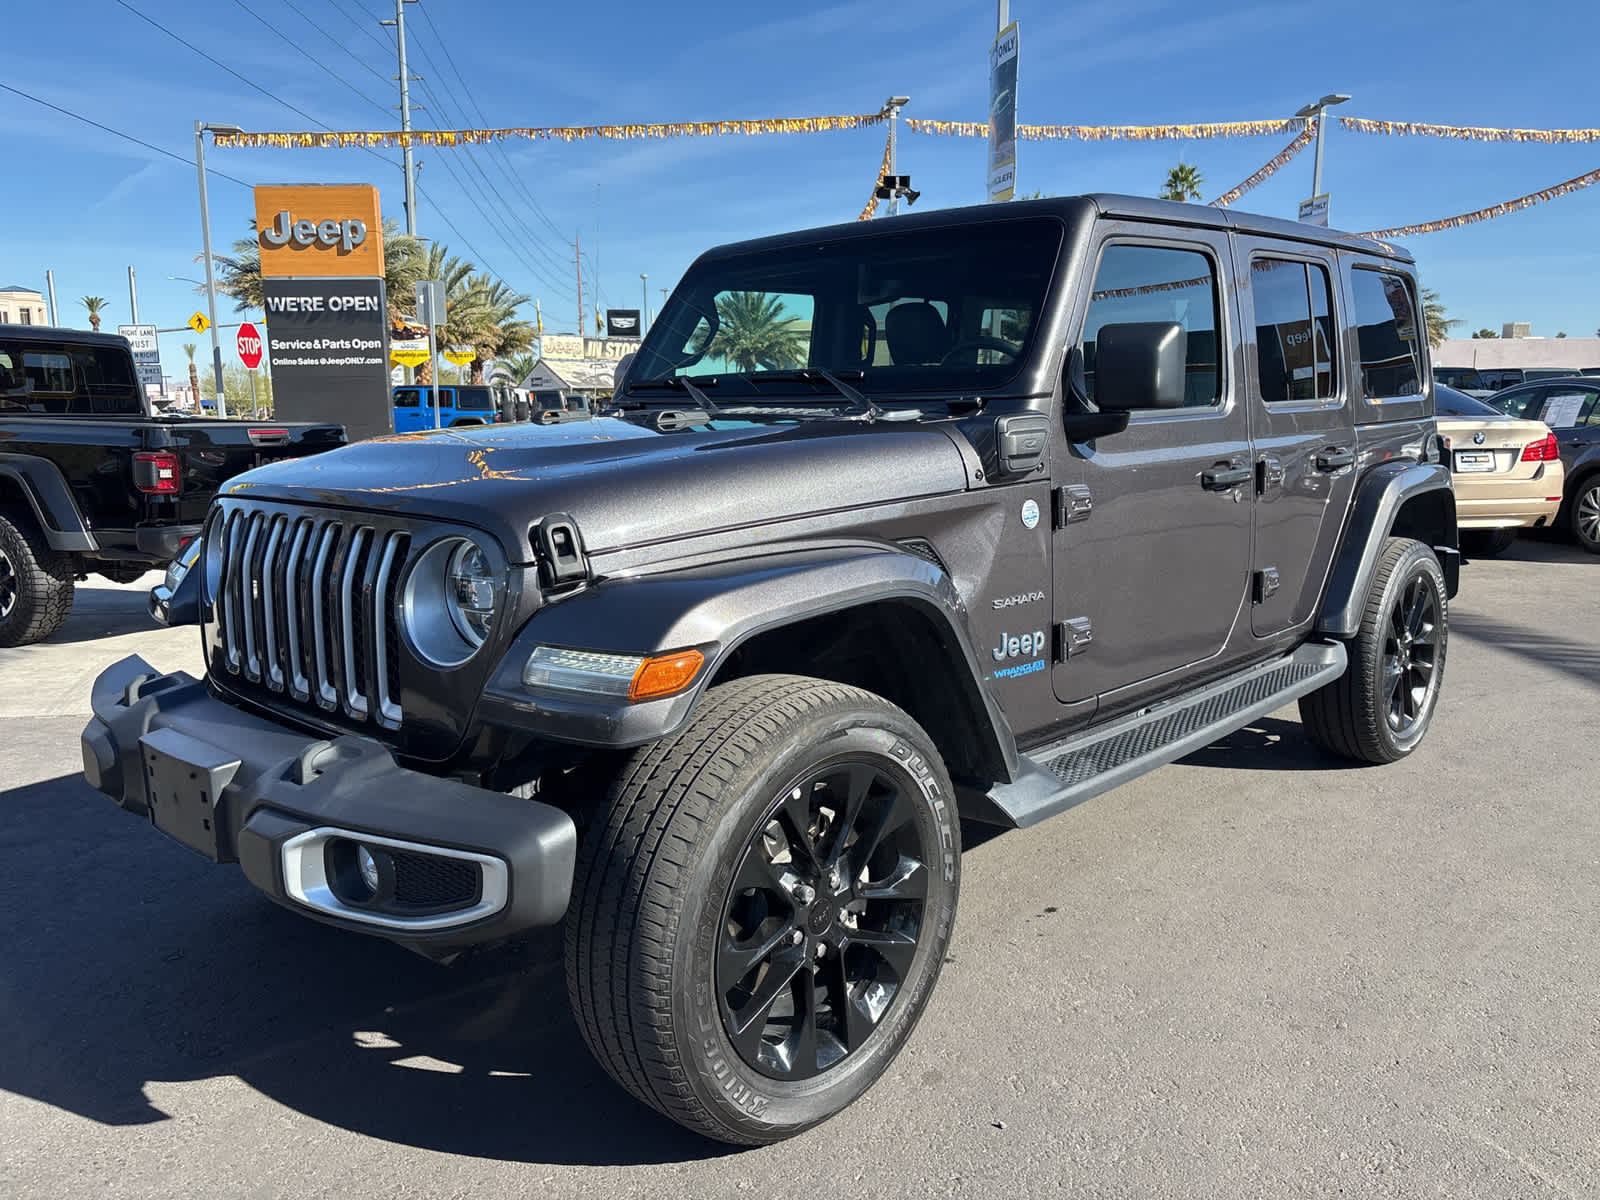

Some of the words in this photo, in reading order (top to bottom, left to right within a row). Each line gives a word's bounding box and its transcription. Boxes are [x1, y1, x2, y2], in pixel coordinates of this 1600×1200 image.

[998, 36, 1016, 57] ONLY
[264, 210, 367, 251] Jeep
[266, 296, 325, 312] WE'RE
[328, 295, 379, 311] OPEN
[140, 329, 154, 337] LANE
[238, 337, 261, 355] STOP
[271, 339, 313, 350] Service
[322, 338, 351, 350] Parts
[351, 338, 381, 351] Open
[543, 338, 582, 358] Jeep
[586, 340, 603, 358] IN
[272, 357, 297, 366] Online
[297, 357, 319, 366] Sales
[992, 591, 1046, 609] SAHARA
[992, 630, 1045, 661] Jeep
[887, 739, 954, 882] DUELER
